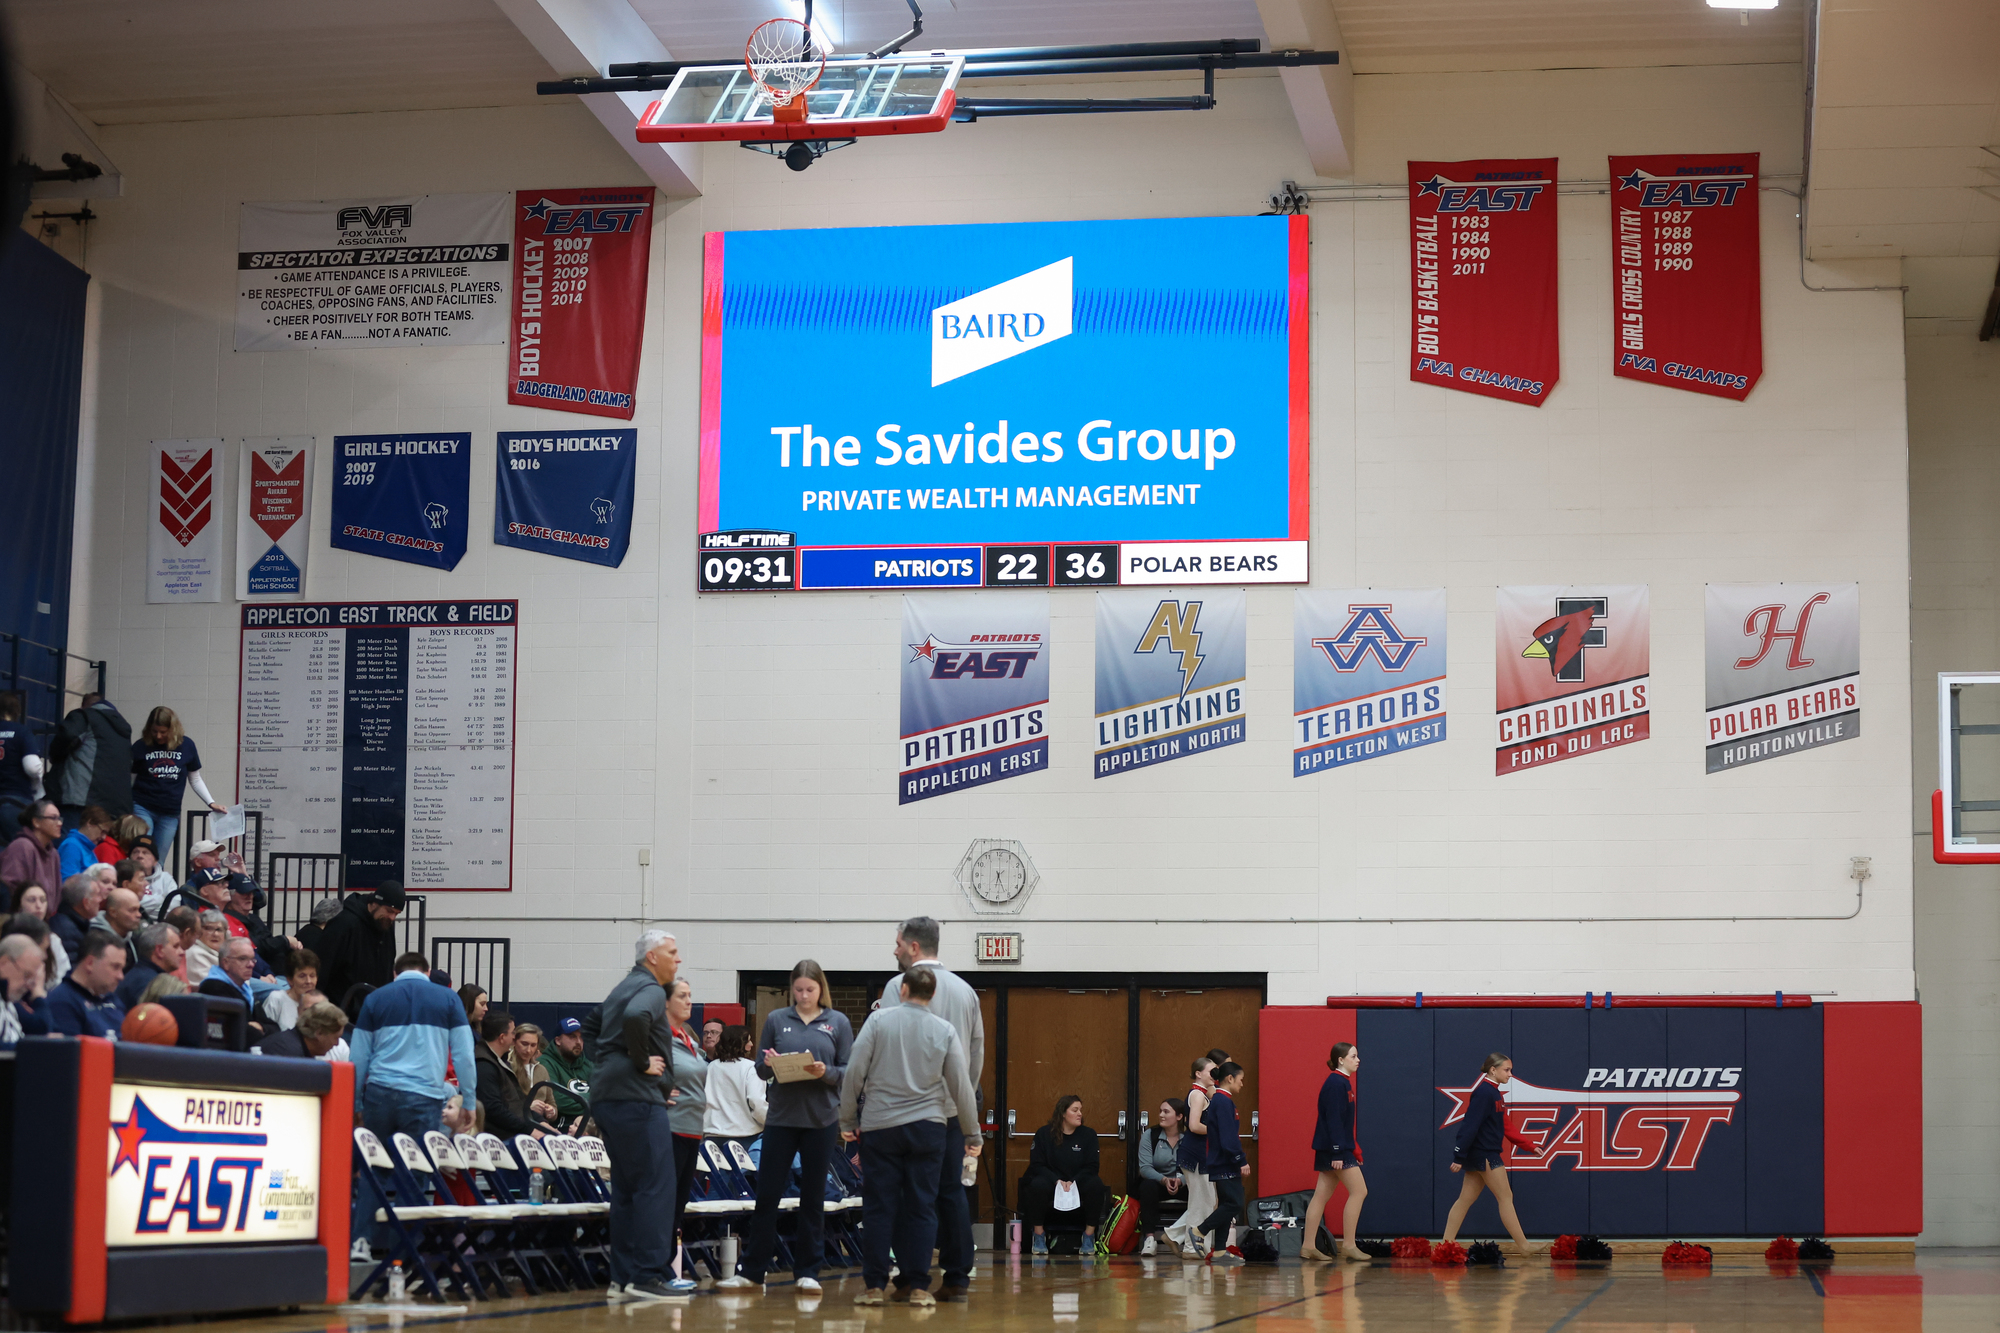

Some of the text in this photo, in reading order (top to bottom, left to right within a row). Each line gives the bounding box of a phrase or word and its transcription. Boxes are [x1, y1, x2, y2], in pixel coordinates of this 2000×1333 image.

[1475, 171, 1543, 180] PATRIOTS
[1676, 165, 1745, 175] PATRIOTS
[580, 194, 643, 202] PATRIOTS
[1436, 187, 1543, 213] EAST
[1639, 181, 1746, 207] EAST
[337, 205, 412, 230] FVA
[543, 209, 643, 235] EAST
[1451, 216, 1490, 229] 1983
[1653, 211, 1693, 224] 1987
[337, 236, 407, 246] ASSOCIATION
[366, 228, 403, 236] VALLEY
[1451, 232, 1490, 244] 1984
[1653, 226, 1692, 239] 1988
[553, 238, 593, 251] 2007
[1451, 247, 1490, 260] 1990
[1654, 242, 1693, 255] 1989
[250, 246, 498, 267] SPECTATOR EXPECTATIONS
[553, 253, 588, 265] 2008
[1654, 258, 1693, 271] 1990
[281, 267, 470, 282] GAME ATTENDANCE IS A PRIVILEGE.
[553, 267, 588, 279] 2009
[1452, 263, 1485, 275] 2011
[1620, 206, 1644, 350] GIRLS CROSS COUNTRY
[248, 282, 503, 299] BE RESPECTFUL OF GAME OFFICIALS, PLAYERS,
[551, 280, 586, 292] 2010
[1416, 215, 1439, 355] BOYS BASKETBALL
[261, 294, 497, 311] COACHES, OPPOSING FANS, AND FACILITIES.
[519, 237, 544, 376] BOYS HOCKEY
[551, 293, 582, 305] 2014
[273, 310, 474, 326] CHEER POSITIVELY FOR BOTH TEAMS.
[940, 312, 1045, 343] BAIRD
[294, 331, 308, 341] BE
[310, 331, 318, 340] A
[392, 328, 400, 338] A
[403, 327, 451, 337] FANATIC.
[1417, 358, 1544, 396] FVA CHAMPS
[1620, 353, 1748, 389] FVA CHAMPS
[517, 380, 630, 408] BADGERLAND CHAMPS
[344, 440, 459, 457] GIRLS HOCKEY
[508, 437, 622, 452] BOYS HOCKEY
[771, 420, 1236, 469] The Savides Group
[346, 462, 376, 473] 2007
[510, 459, 540, 470] 2016
[344, 474, 374, 485] 2019
[802, 484, 1200, 511] PRIVATE WEALTH MANAGEMENT
[343, 524, 443, 553] STATE CHAMPS
[508, 522, 610, 549] STATE CHAMPS
[705, 534, 790, 547] HALFTIME
[704, 557, 791, 583] 09:31
[874, 559, 973, 578] PATRIOTS
[997, 553, 1038, 580] 22
[1065, 552, 1106, 579] 36
[1131, 555, 1278, 573] POLAR BEARS
[248, 605, 512, 624] APPLETON EAST TRACK & FIELD
[970, 634, 1041, 642] PATRIOTS
[1733, 592, 1831, 670] H
[929, 652, 1038, 679] EAST
[1099, 687, 1241, 746] LIGHTNING
[1298, 685, 1440, 743] TERRORS
[1499, 685, 1646, 742] CARDINALS
[1710, 684, 1856, 740] POLAR BEARS
[905, 710, 1044, 766] PATRIOTS
[1300, 722, 1441, 770] APPLETON WEST
[1511, 724, 1634, 767] FOND DU LAC
[1723, 722, 1843, 764] HORTONVILLE
[146, 751, 182, 761] PATRIOTS
[1100, 724, 1240, 773] APPLETON NORTH
[907, 749, 1041, 795] APPLETON EAST
[986, 938, 1011, 957] EXIT
[1583, 1067, 1741, 1088] PATRIOTS
[184, 1098, 263, 1126] PATRIOTS
[1500, 1106, 1734, 1171] EAST
[135, 1156, 263, 1234] EAST
